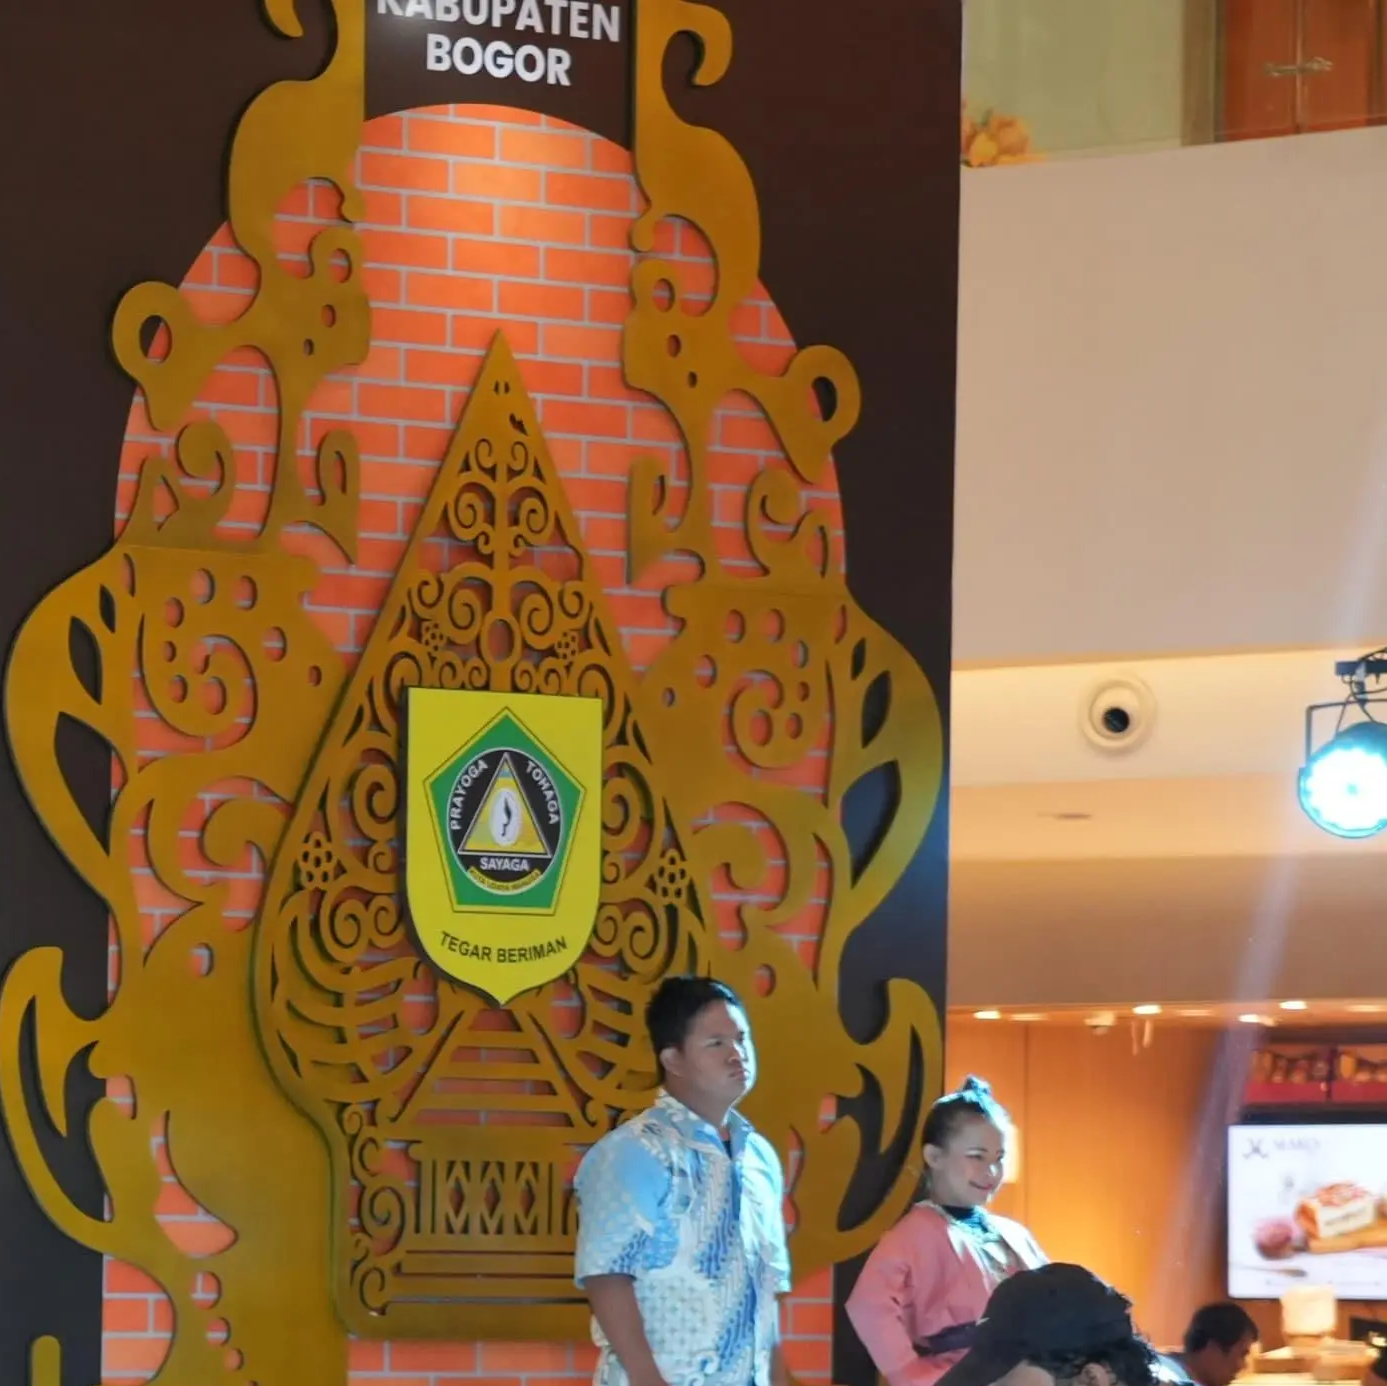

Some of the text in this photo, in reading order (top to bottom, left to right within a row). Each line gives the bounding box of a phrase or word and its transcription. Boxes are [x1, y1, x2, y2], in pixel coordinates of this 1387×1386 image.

[427, 33, 572, 86] BOGOR
[449, 759, 488, 831] PRAYOGA
[479, 856, 530, 872] SAYAGA
[440, 930, 569, 963] TEGAR BERIMAN
